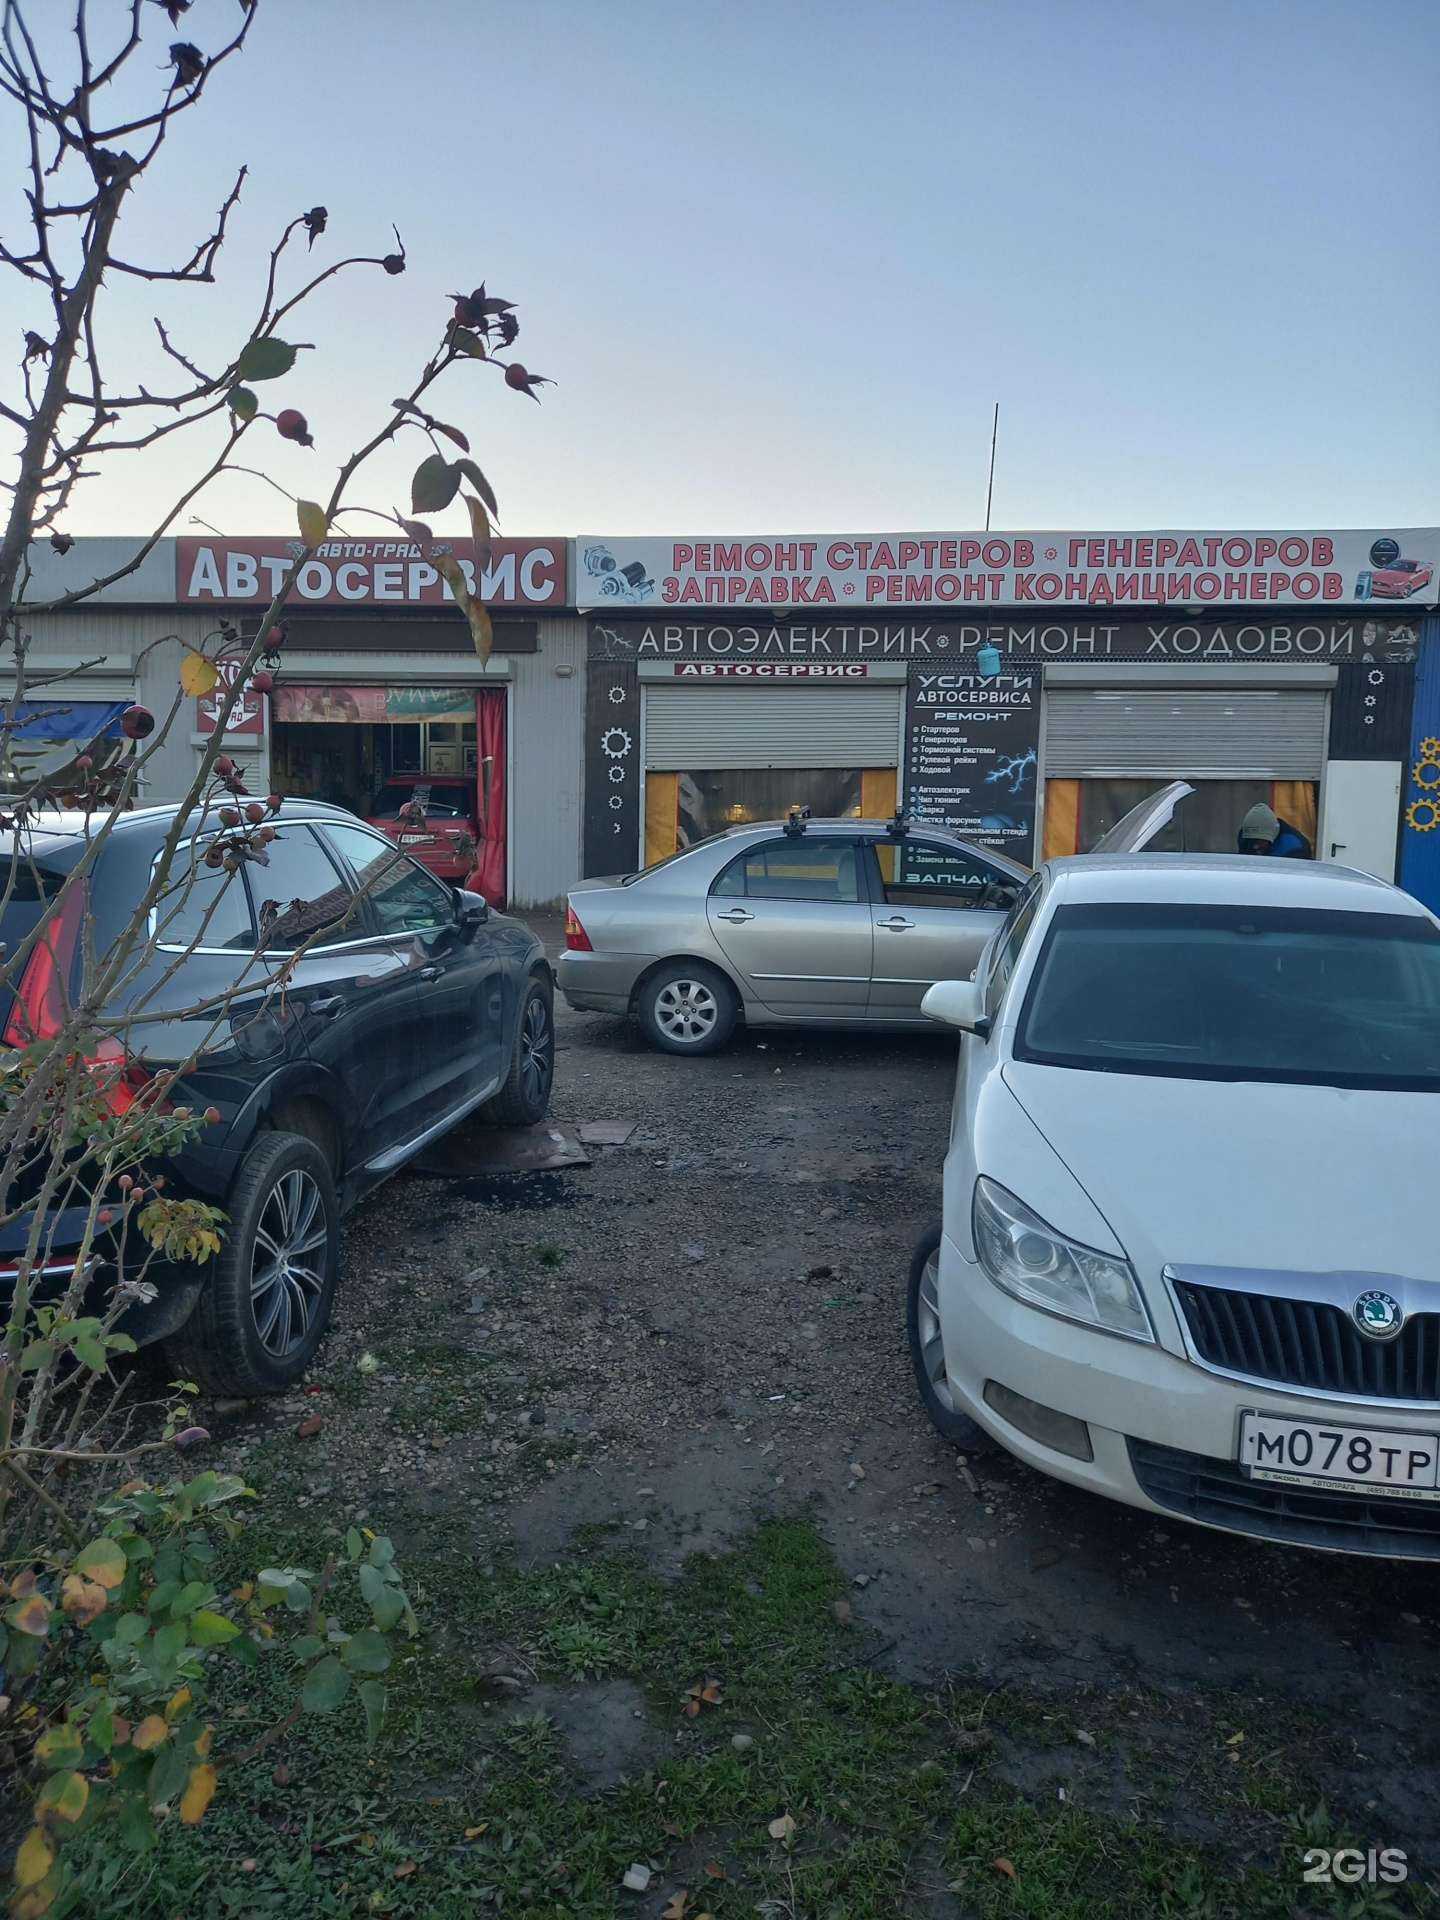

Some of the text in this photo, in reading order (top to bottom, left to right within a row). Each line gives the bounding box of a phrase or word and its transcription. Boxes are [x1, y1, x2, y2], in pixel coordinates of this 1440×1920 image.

[672, 537, 1335, 571] РЕМОНТ СТАРТЕРОВ ГЕНЕРАТОРОВ
[661, 572, 1344, 604] ЗАПРАВКА РЕМОНТ КОНДИЦИОНЕРОВ
[637, 618, 1354, 657] АВТОЭЛЕКТРИК РЕМОНТ ХОДОВОЙ
[681, 664, 865, 677] АВТОСЕРВИС
[917, 675, 1033, 688] УСЛУГИ
[916, 691, 1031, 704] АВТОСЕРВИСА
[934, 712, 1012, 721] РЕМОНТ
[921, 725, 960, 734] Стартеров
[920, 735, 968, 744] Генераторов
[920, 745, 961, 754] Тормозной
[920, 755, 951, 764] Рулевой
[919, 765, 951, 774] Ходовой
[918, 786, 970, 795] Автоэлектрик
[934, 796, 962, 804] тюнинг
[918, 805, 945, 814] Сварка
[1312, 1479, 1356, 1491] АВТОПРАГА
